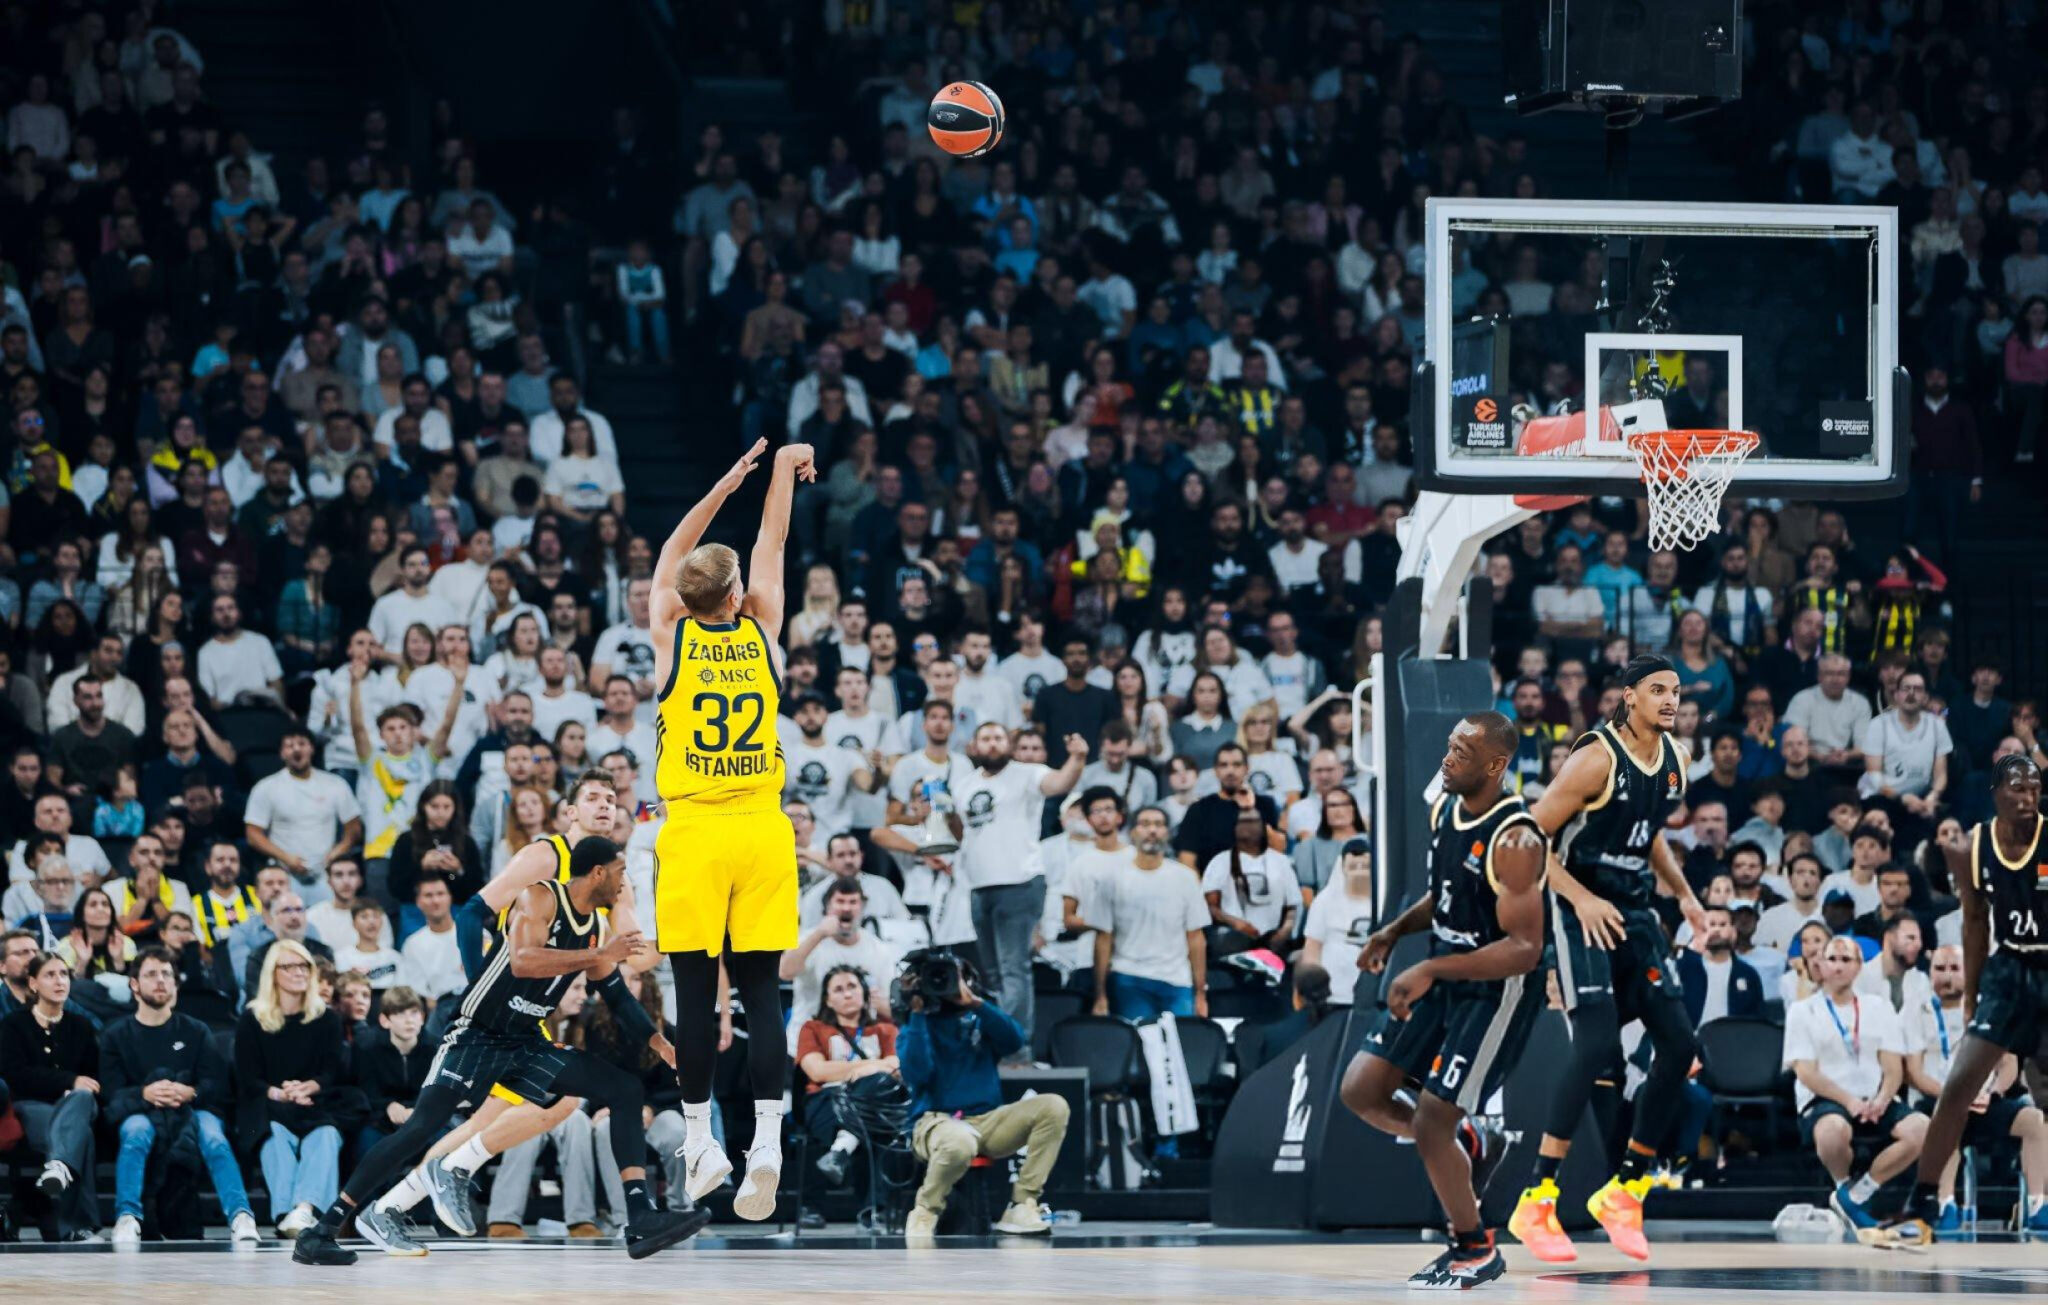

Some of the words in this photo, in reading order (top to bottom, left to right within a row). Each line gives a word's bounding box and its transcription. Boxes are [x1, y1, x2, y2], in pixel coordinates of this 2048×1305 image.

[1468, 423, 1505, 431] TURKISH
[1468, 431, 1505, 439] AIRLINES
[687, 639, 761, 662] ŽAGARS
[720, 668, 757, 682] MSC
[692, 692, 765, 752] 32
[2008, 909, 2039, 936] 24
[1442, 1054, 1467, 1089] 6
